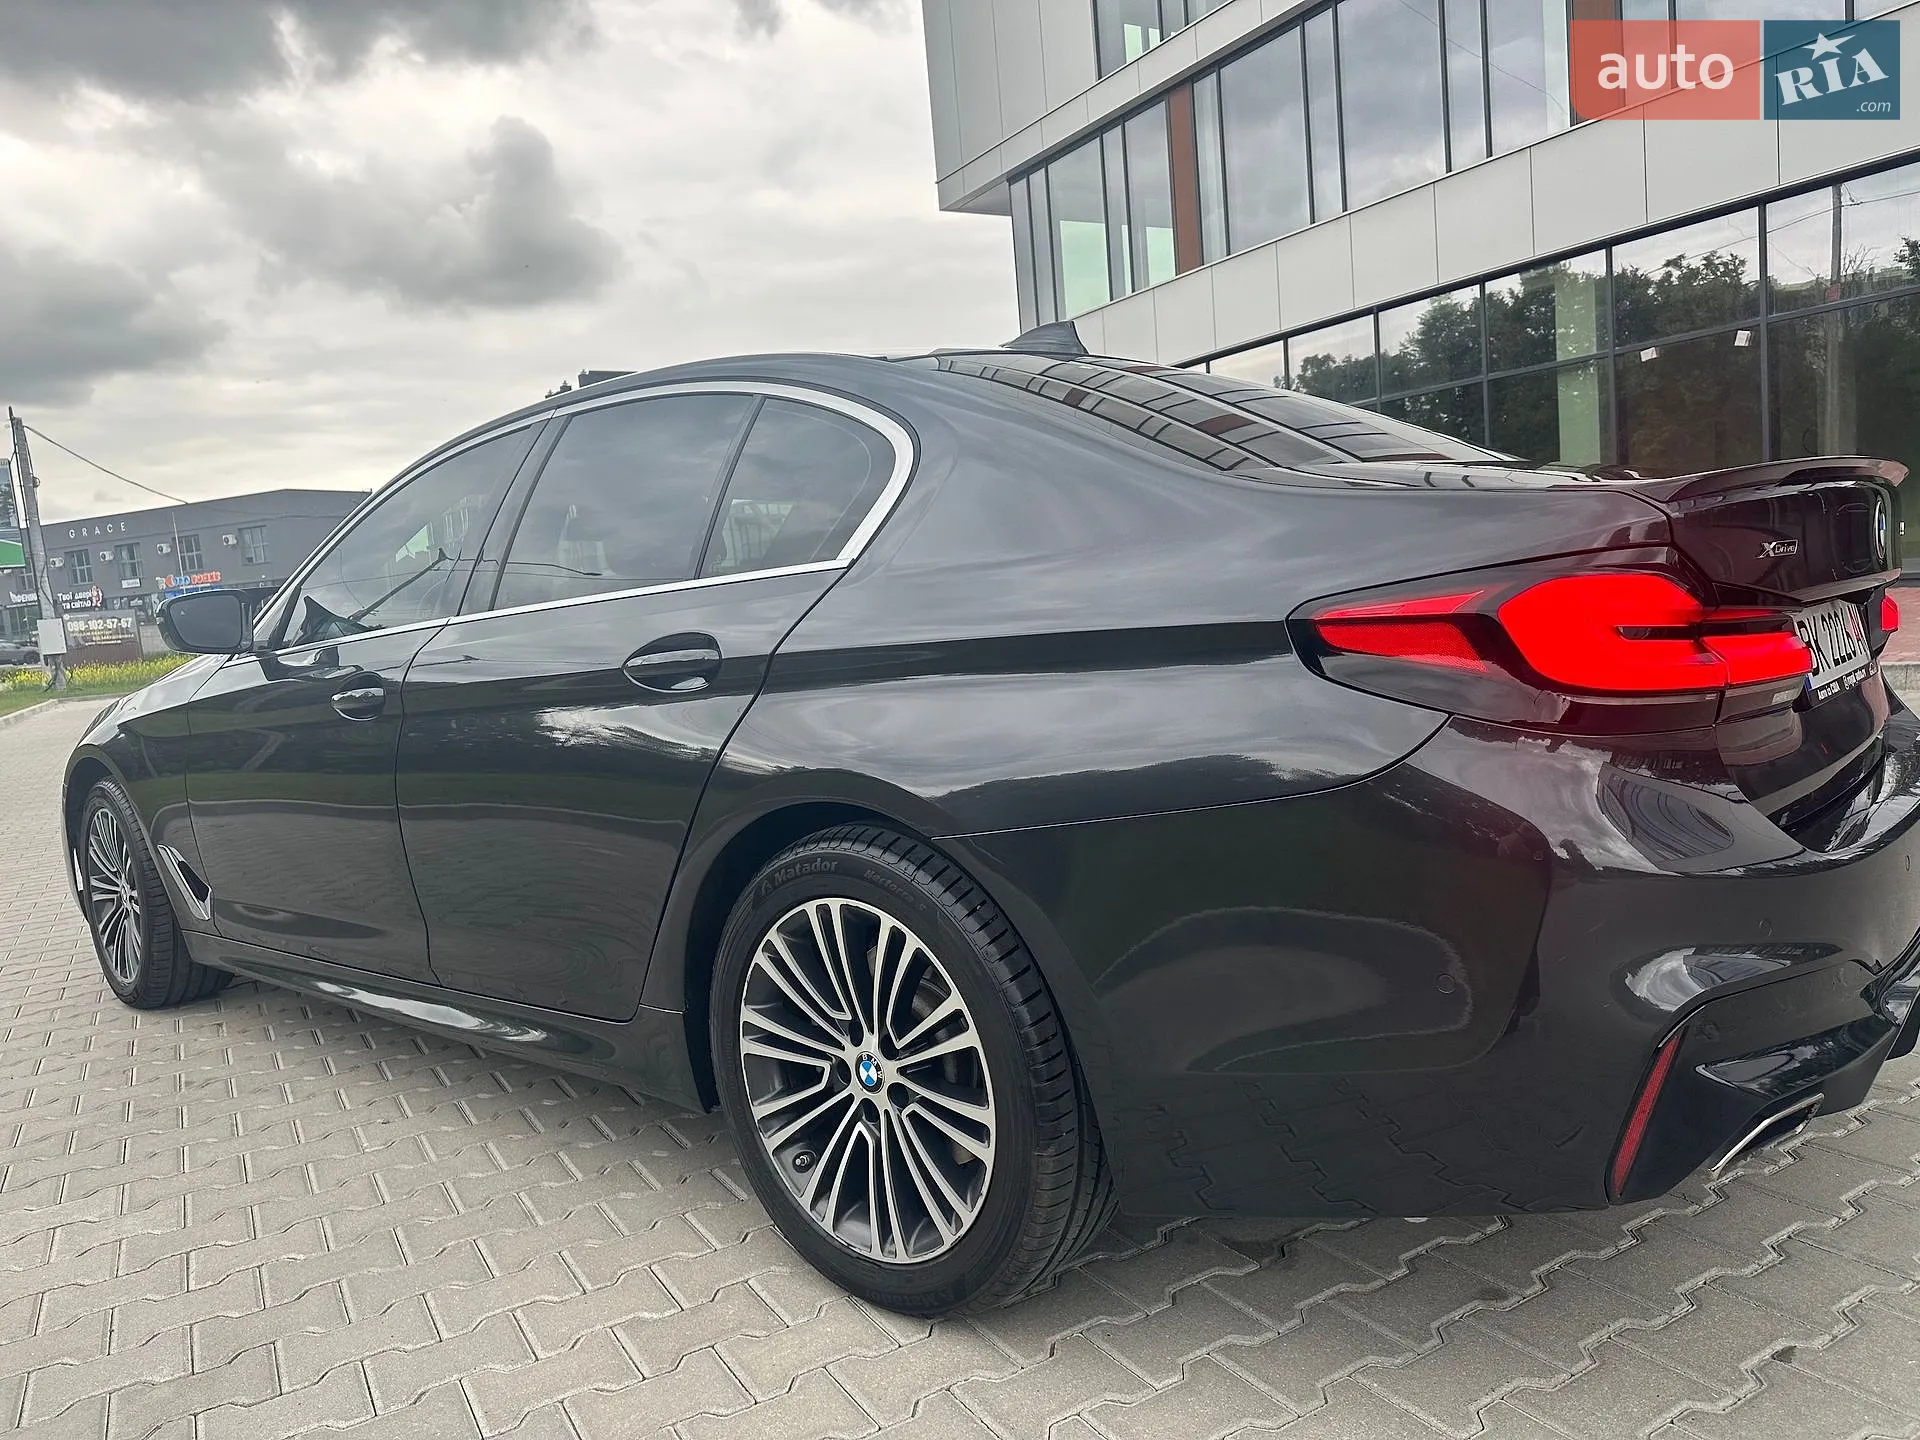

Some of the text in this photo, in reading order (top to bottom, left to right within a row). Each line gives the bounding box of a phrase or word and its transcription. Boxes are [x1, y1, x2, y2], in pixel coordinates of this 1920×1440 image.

[69, 521, 126, 538] GRACE
[1821, 607, 1857, 667] 2226
[774, 858, 838, 881] Matador
[861, 1054, 883, 1079] BMW
